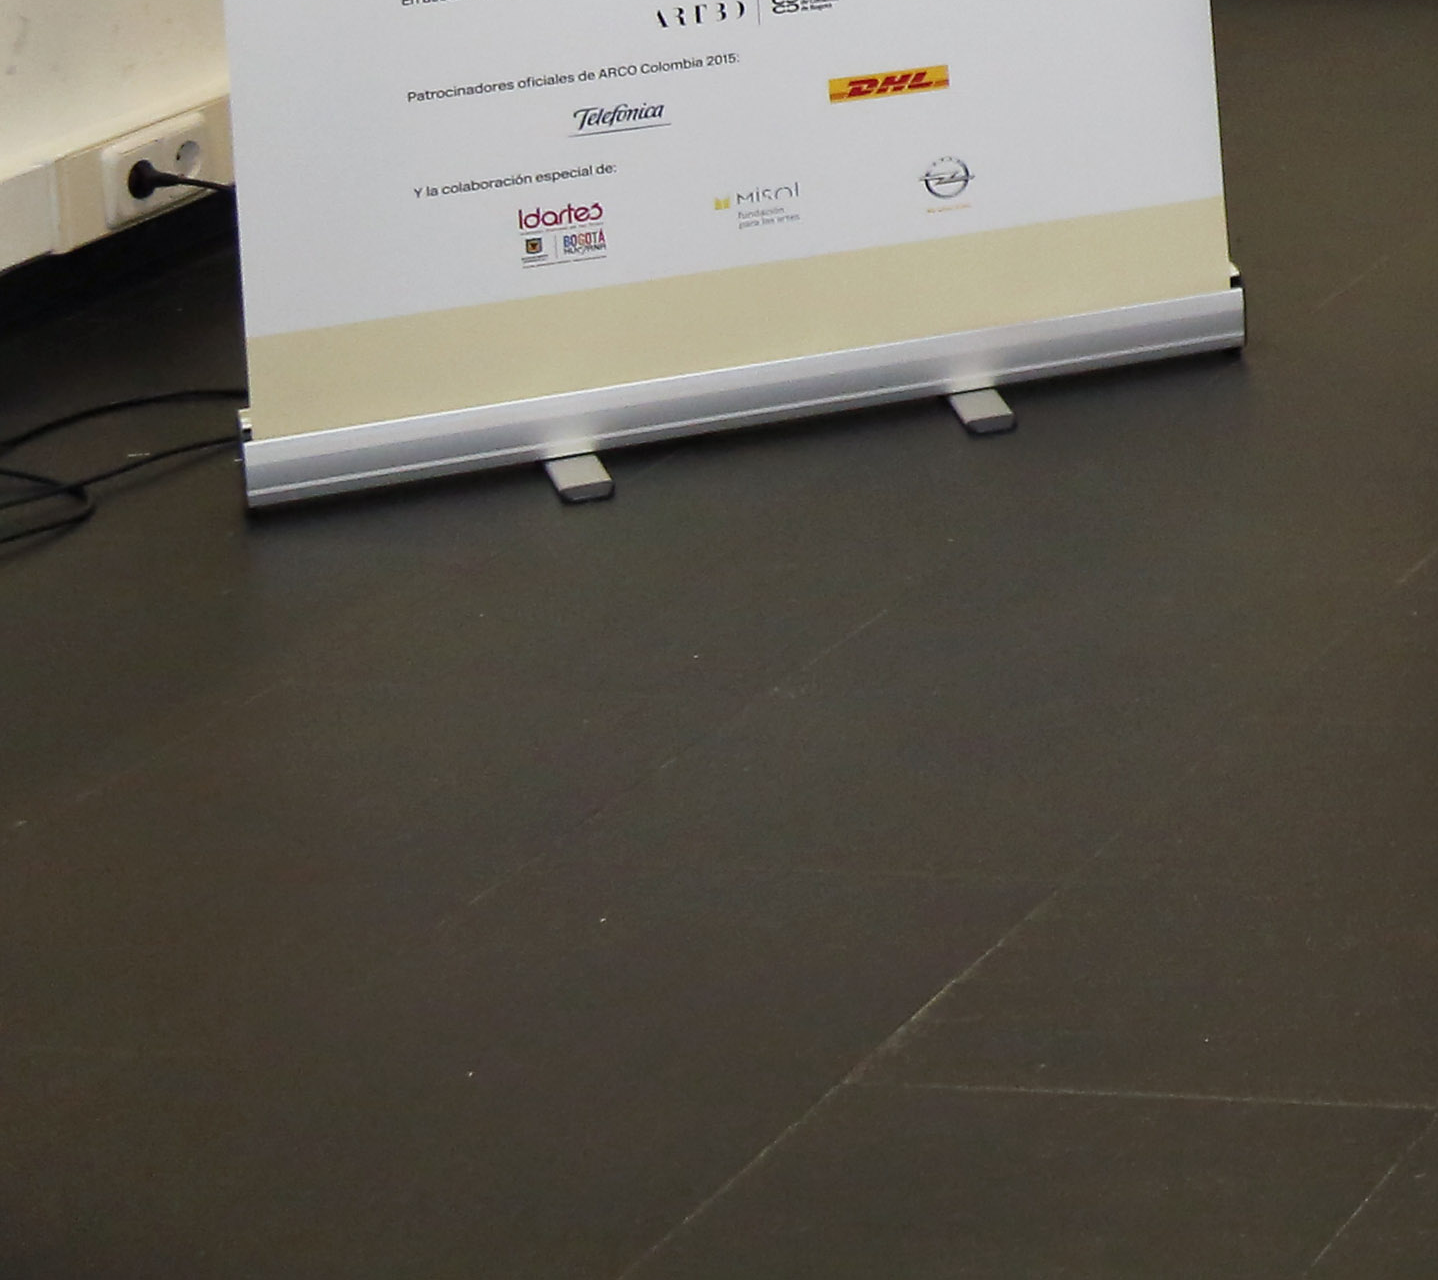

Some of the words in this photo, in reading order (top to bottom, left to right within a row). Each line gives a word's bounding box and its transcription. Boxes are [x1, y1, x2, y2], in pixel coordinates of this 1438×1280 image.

[408, 81, 514, 102] Patrocinadores
[518, 74, 574, 89] oficiales
[578, 70, 595, 82] de
[599, 65, 637, 80] ARCO
[640, 58, 703, 74] Colombia
[706, 53, 739, 67] 2015:
[848, 72, 933, 97] DHL
[414, 187, 422, 199] Y
[426, 186, 438, 197] la
[441, 173, 532, 195] colaboración
[535, 164, 592, 183] especial
[596, 163, 616, 175] de:
[519, 203, 603, 229] Idartes
